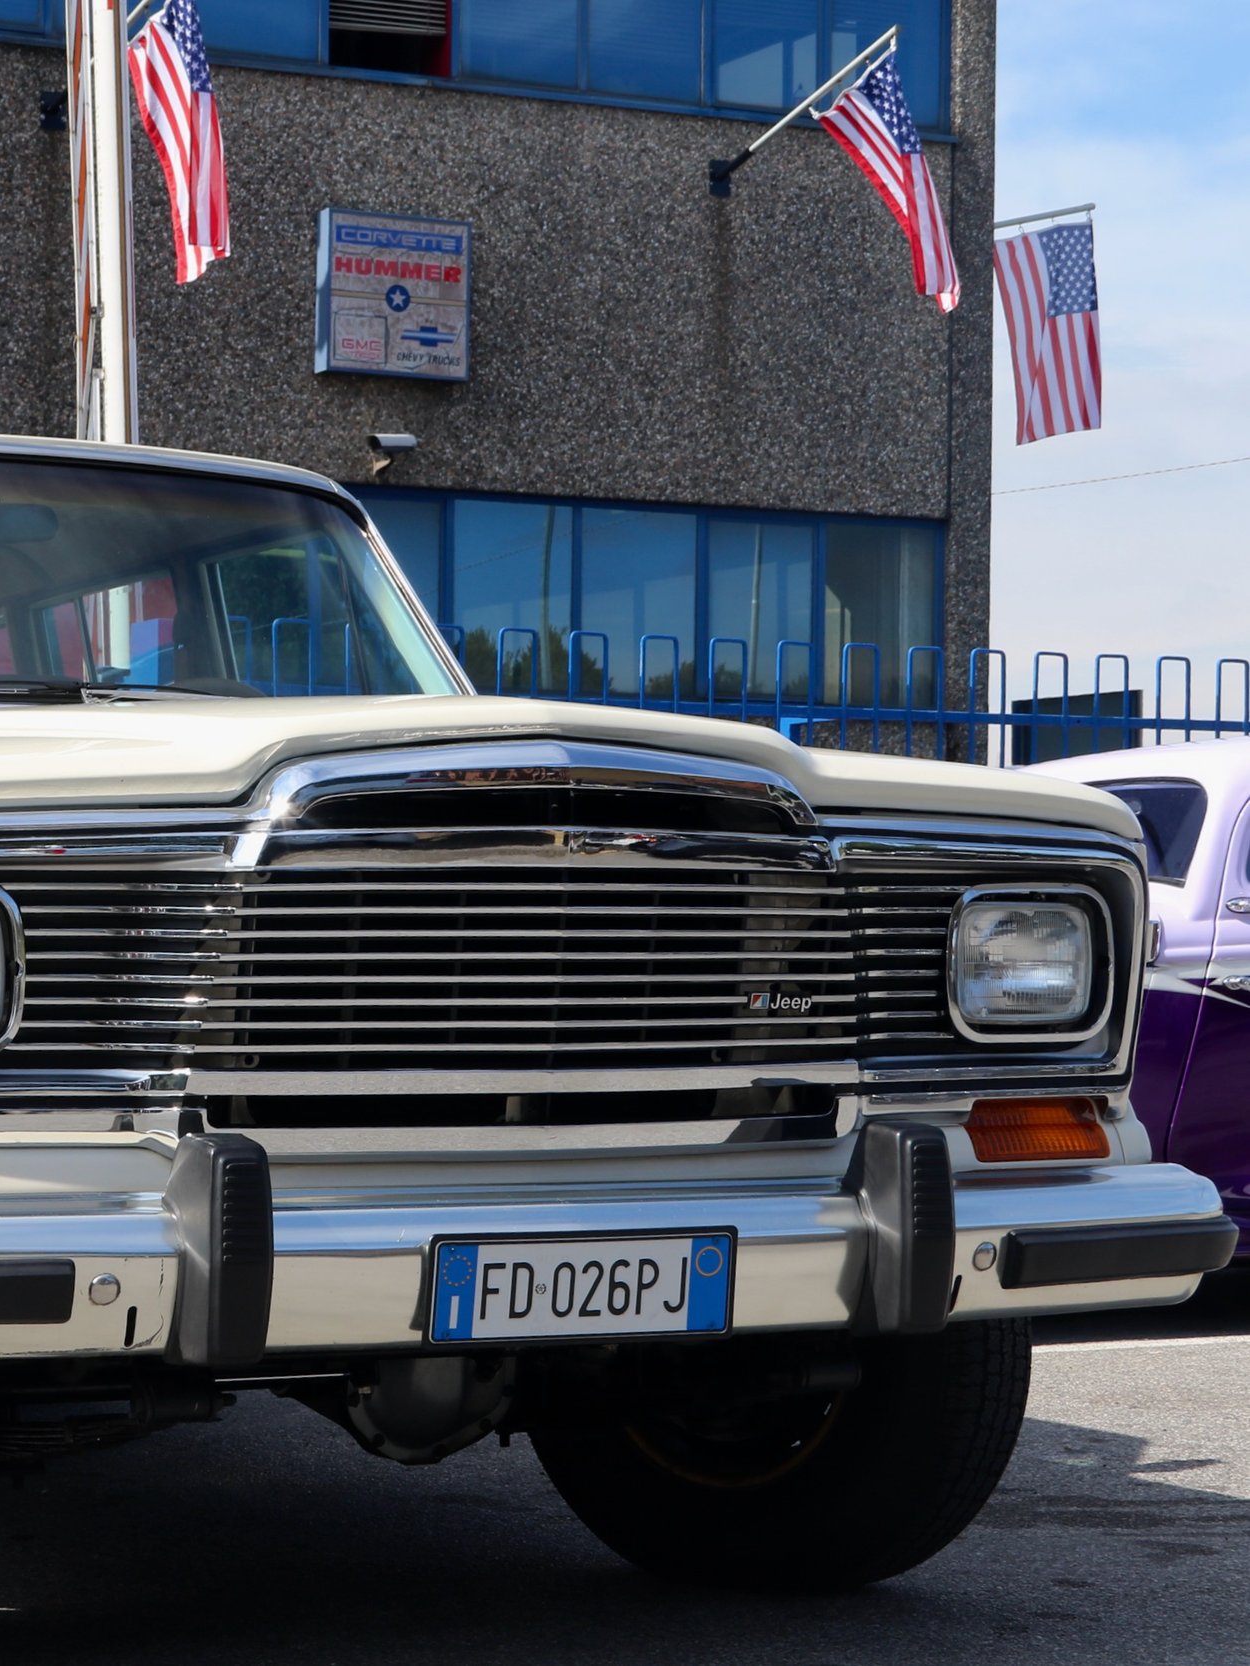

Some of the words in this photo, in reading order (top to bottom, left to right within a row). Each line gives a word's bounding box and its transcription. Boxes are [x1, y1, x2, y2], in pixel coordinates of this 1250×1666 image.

[340, 227, 457, 251] CORVETTE
[334, 256, 463, 283] HUMMER
[341, 337, 383, 352] GMC
[396, 352, 425, 364] CHEVY
[427, 353, 462, 367] TRUCKS
[770, 993, 812, 1012] Jeep
